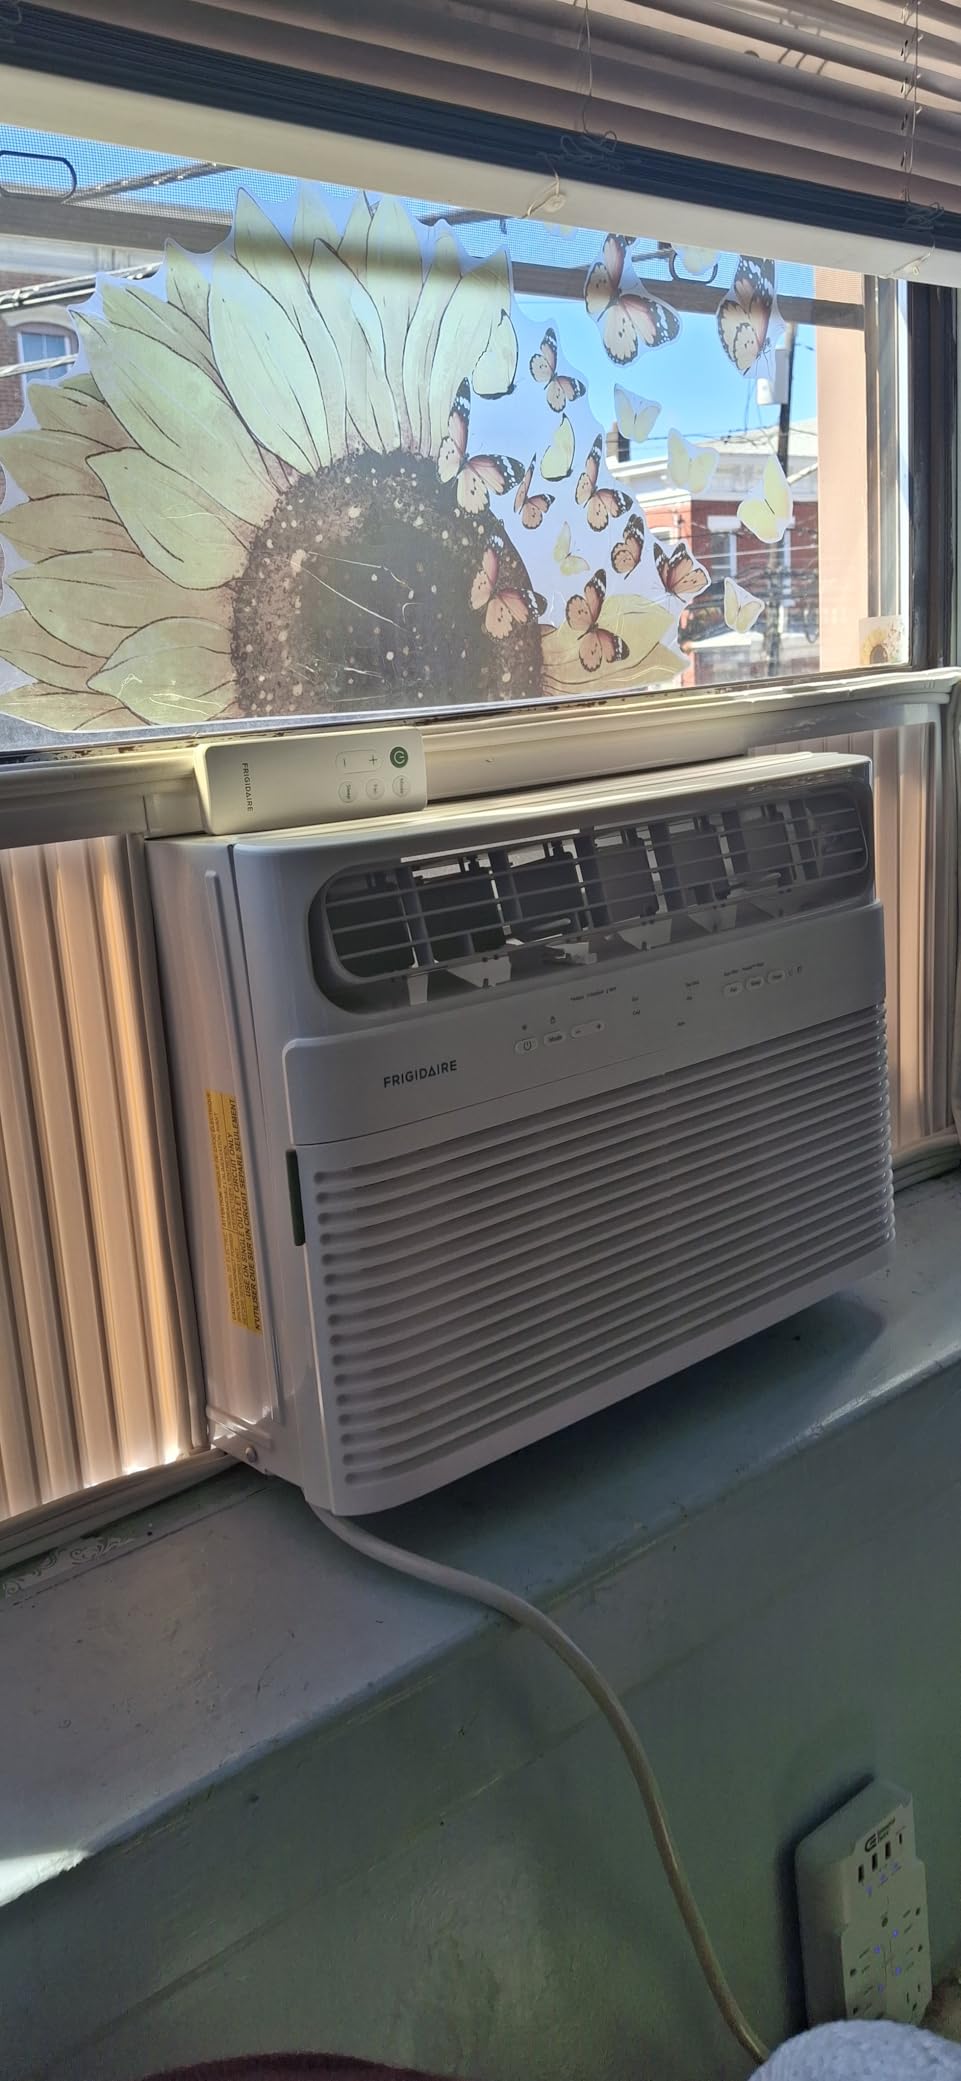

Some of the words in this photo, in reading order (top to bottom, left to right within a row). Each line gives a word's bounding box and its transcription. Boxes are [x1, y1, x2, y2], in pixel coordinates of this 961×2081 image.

[241, 762, 254, 812] FRIGIDAIRE
[383, 1059, 457, 1088] FRIGIDAIRE
[230, 1098, 241, 1151] SEULEMENT
[231, 1159, 239, 1193] CIRCUIT
[234, 1194, 243, 1229] OUTLET
[240, 1192, 249, 1225] CIRCUIT
[245, 1227, 251, 1240] UN
[243, 1264, 248, 1277] ON
